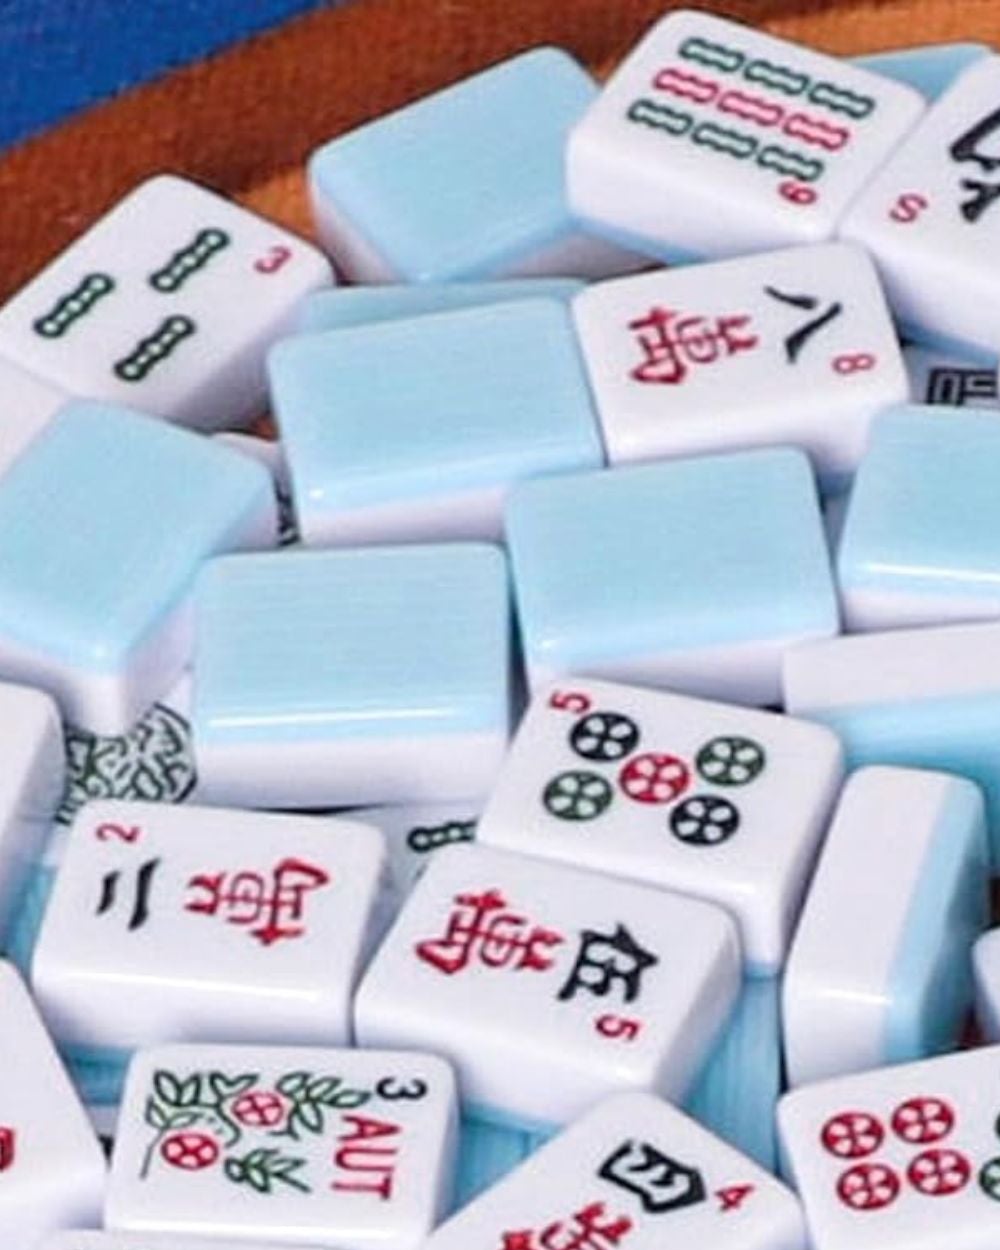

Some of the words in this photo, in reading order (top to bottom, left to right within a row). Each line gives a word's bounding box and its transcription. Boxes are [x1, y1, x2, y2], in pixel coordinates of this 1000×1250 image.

[889, 194, 928, 223] S
[254, 246, 292, 274] 3
[832, 354, 875, 375] 8
[549, 690, 592, 714] 5
[96, 824, 139, 843] 2
[595, 1014, 641, 1041] 5
[377, 1077, 428, 1101] 3
[331, 1113, 402, 1201] AUT
[714, 1184, 755, 1212] 4
